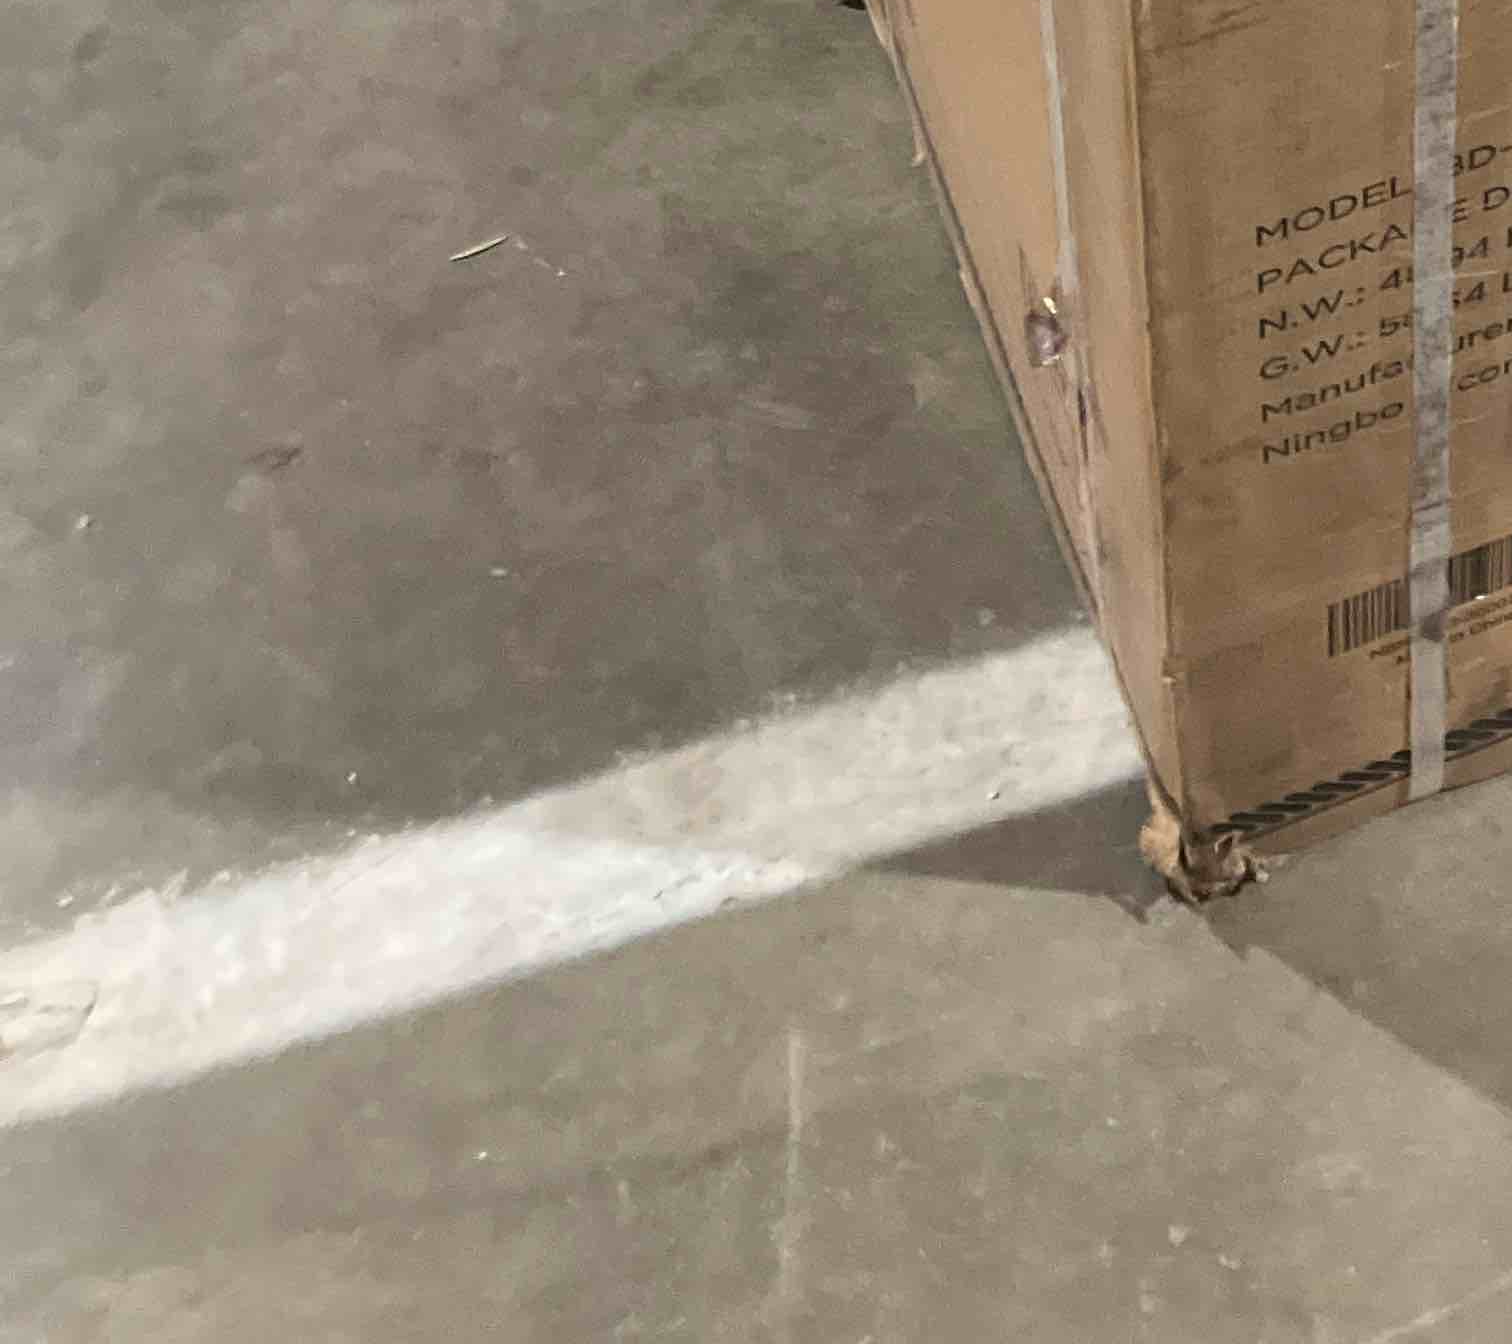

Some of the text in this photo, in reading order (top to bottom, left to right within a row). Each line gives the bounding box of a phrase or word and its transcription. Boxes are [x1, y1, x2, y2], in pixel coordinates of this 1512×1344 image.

[1256, 198, 1469, 295] PACKAE
[1258, 284, 1367, 342] N.W.:
[1258, 327, 1367, 383] G.W.:
[1261, 400, 1406, 467] Ningbo
